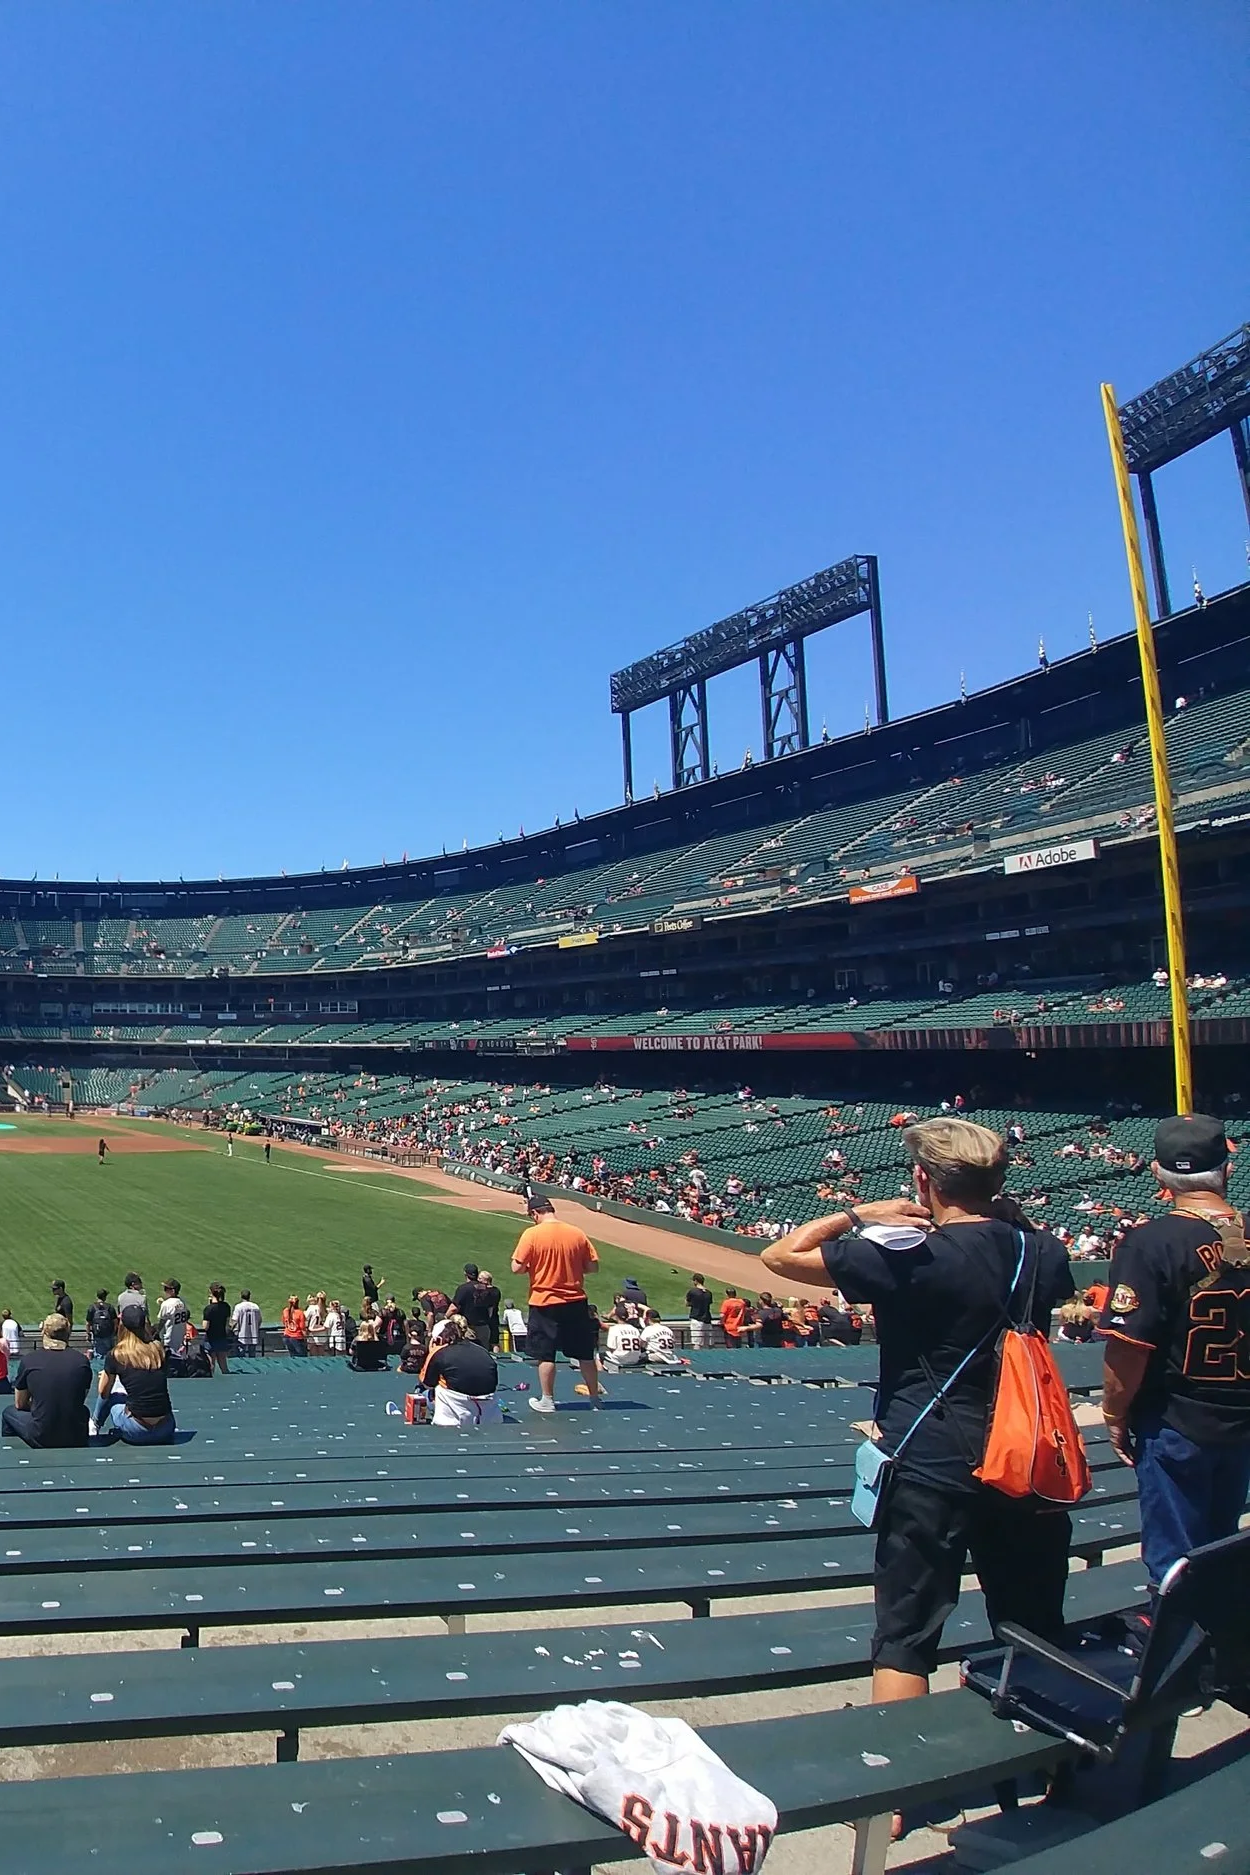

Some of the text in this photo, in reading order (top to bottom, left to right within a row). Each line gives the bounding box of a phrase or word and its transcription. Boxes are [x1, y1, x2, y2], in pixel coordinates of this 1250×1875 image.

[1035, 847, 1077, 867] Adobe
[871, 883, 889, 892] CAKE
[677, 918, 693, 930] Coffee
[633, 1035, 763, 1050] WELCOME TO AT&T PARK!
[1196, 1240, 1225, 1272] PO
[174, 1311, 187, 1325] 28
[621, 1338, 640, 1351] 28
[658, 1338, 674, 1350] 35
